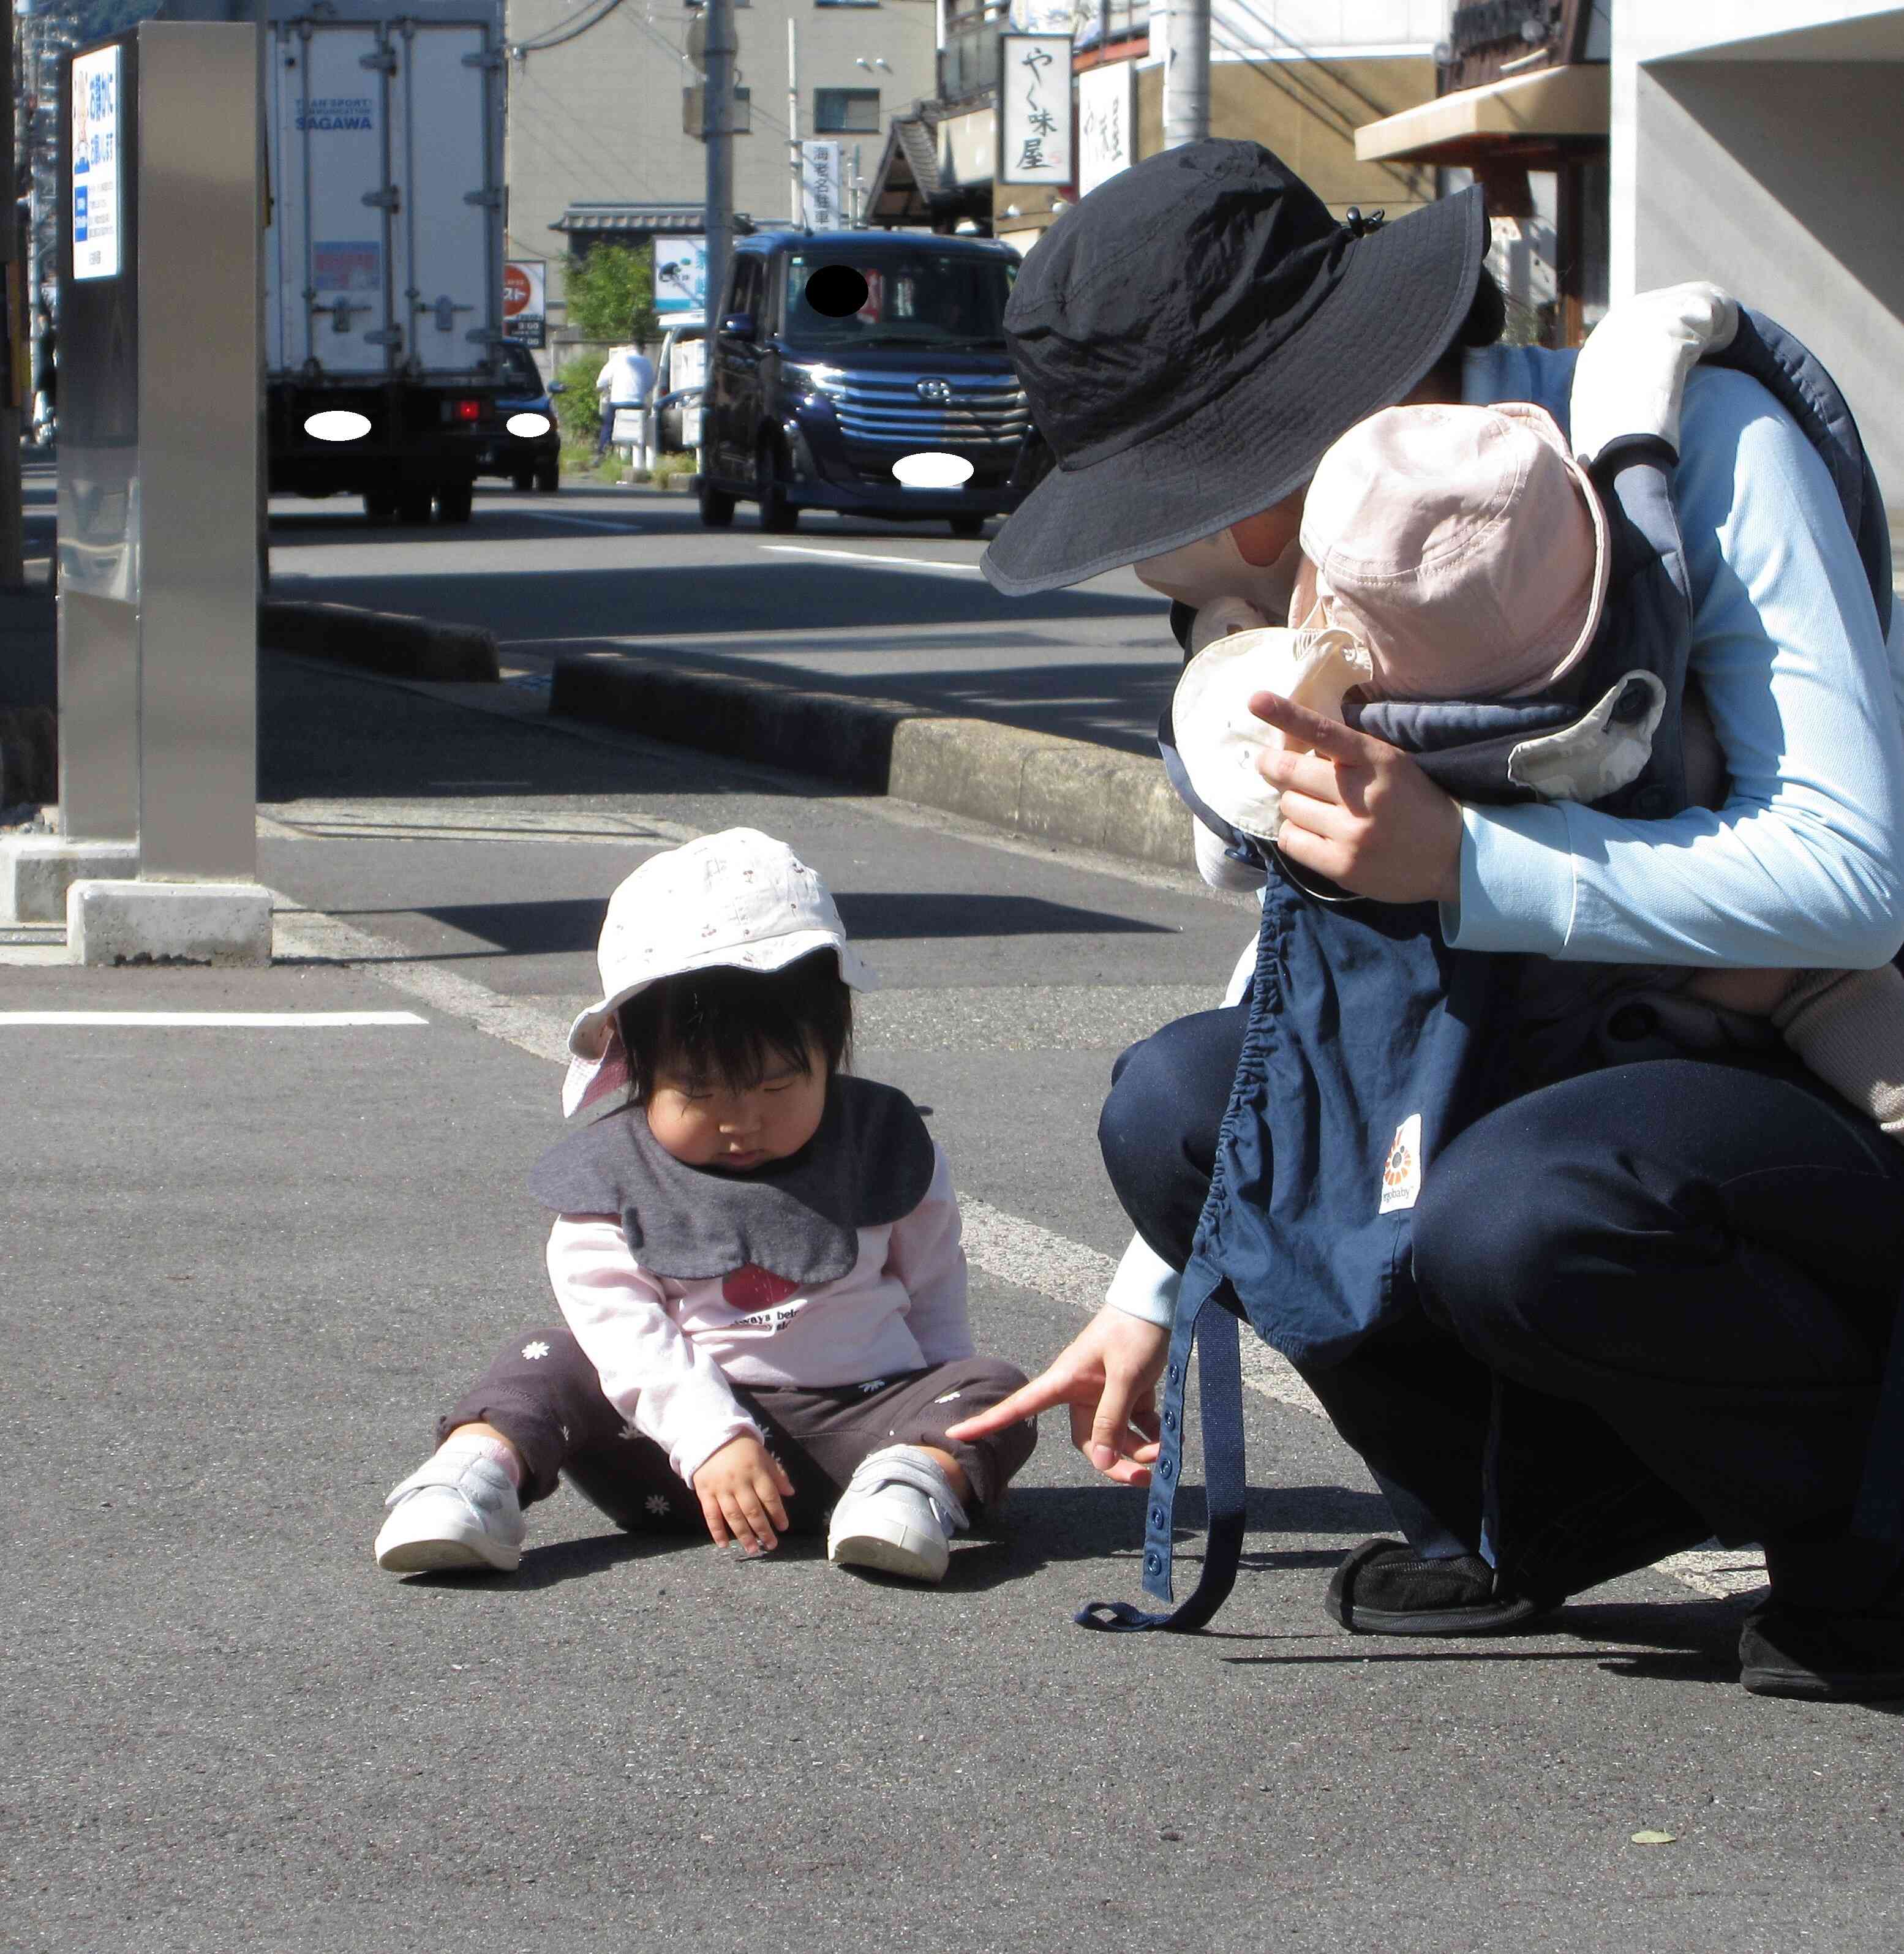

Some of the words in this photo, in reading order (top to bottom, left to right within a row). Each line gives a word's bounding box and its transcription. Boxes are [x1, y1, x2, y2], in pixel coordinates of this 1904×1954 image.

[295, 117, 372, 130] SAGAWA
[1016, 47, 1058, 170] やく味屋
